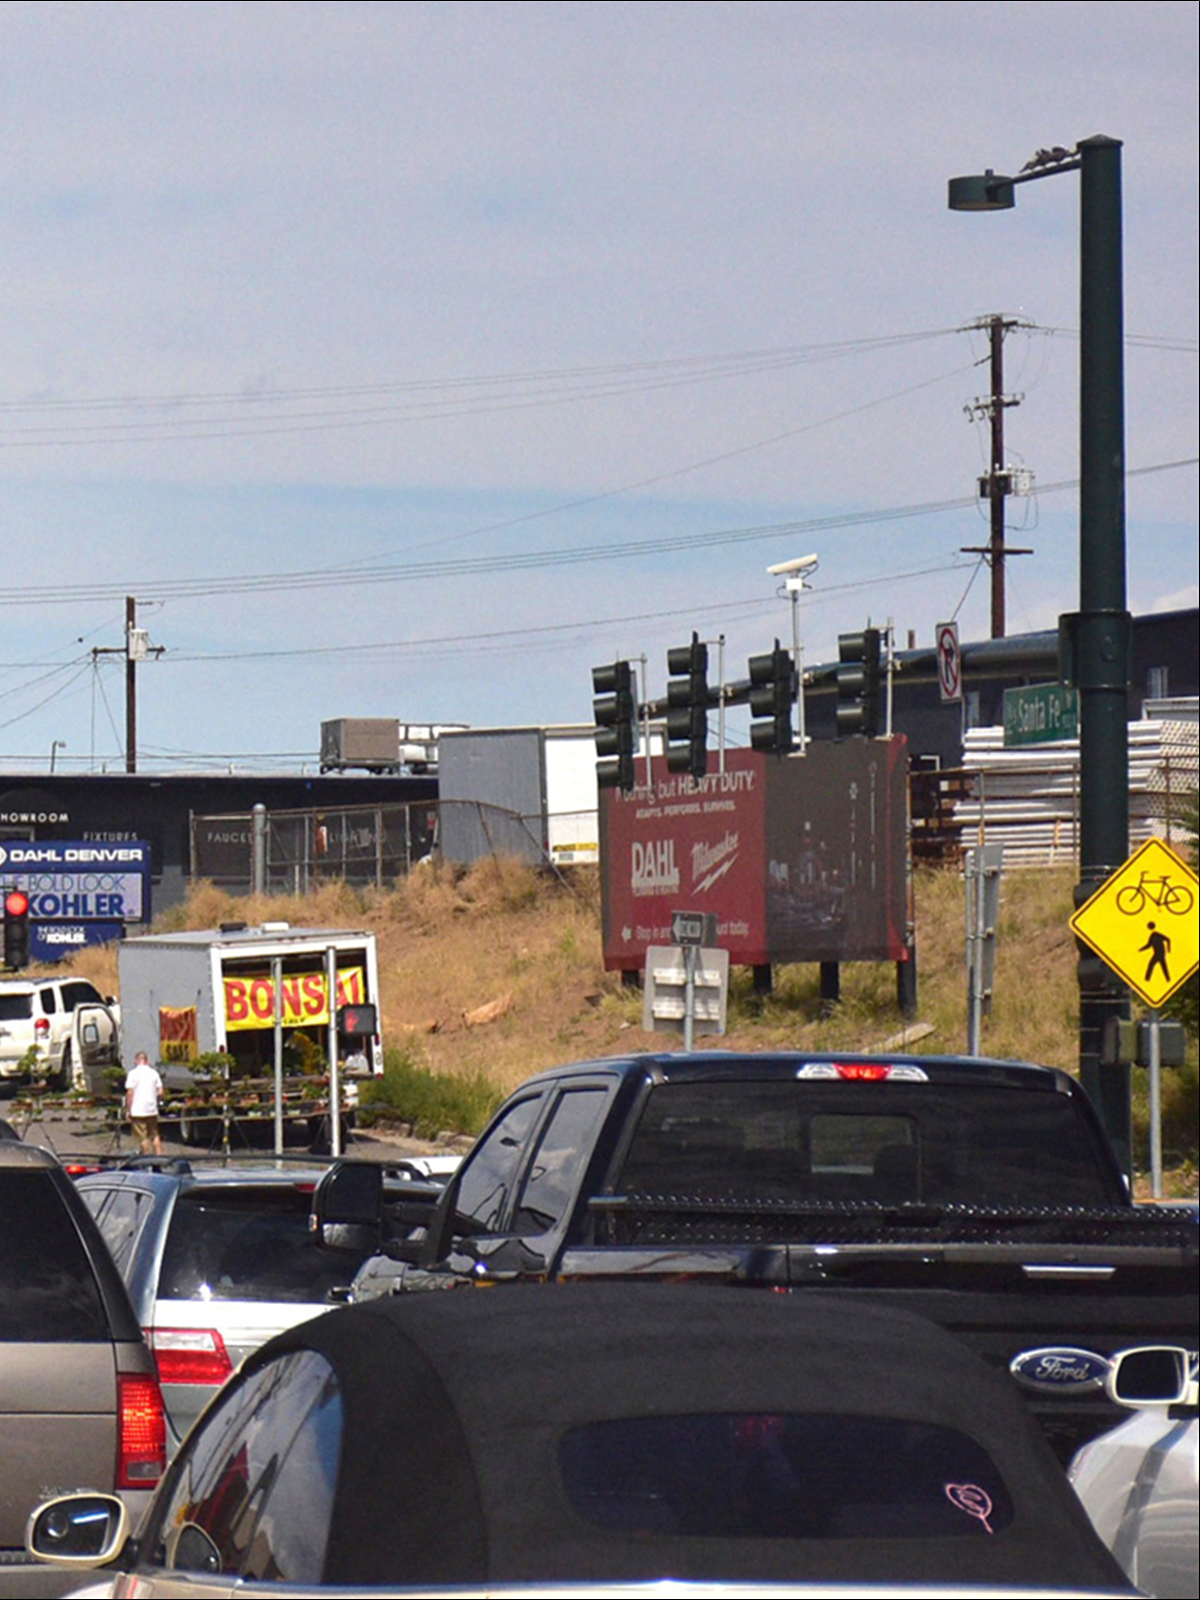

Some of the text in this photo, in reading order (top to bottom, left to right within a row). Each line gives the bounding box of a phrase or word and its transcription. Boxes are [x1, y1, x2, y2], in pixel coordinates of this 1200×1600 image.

[1018, 697, 1046, 731] Santa
[1049, 694, 1060, 728] Fe
[658, 779, 676, 799] but
[678, 773, 718, 796] HEAVY
[82, 831, 138, 841] FIXTURES
[9, 849, 143, 861] DAHL DENVER
[632, 839, 680, 882] DAHL
[28, 874, 75, 892] BOLD
[77, 874, 126, 892] LOOK
[28, 893, 125, 916] KOHLER
[1035, 1356, 1090, 1380] Ford
